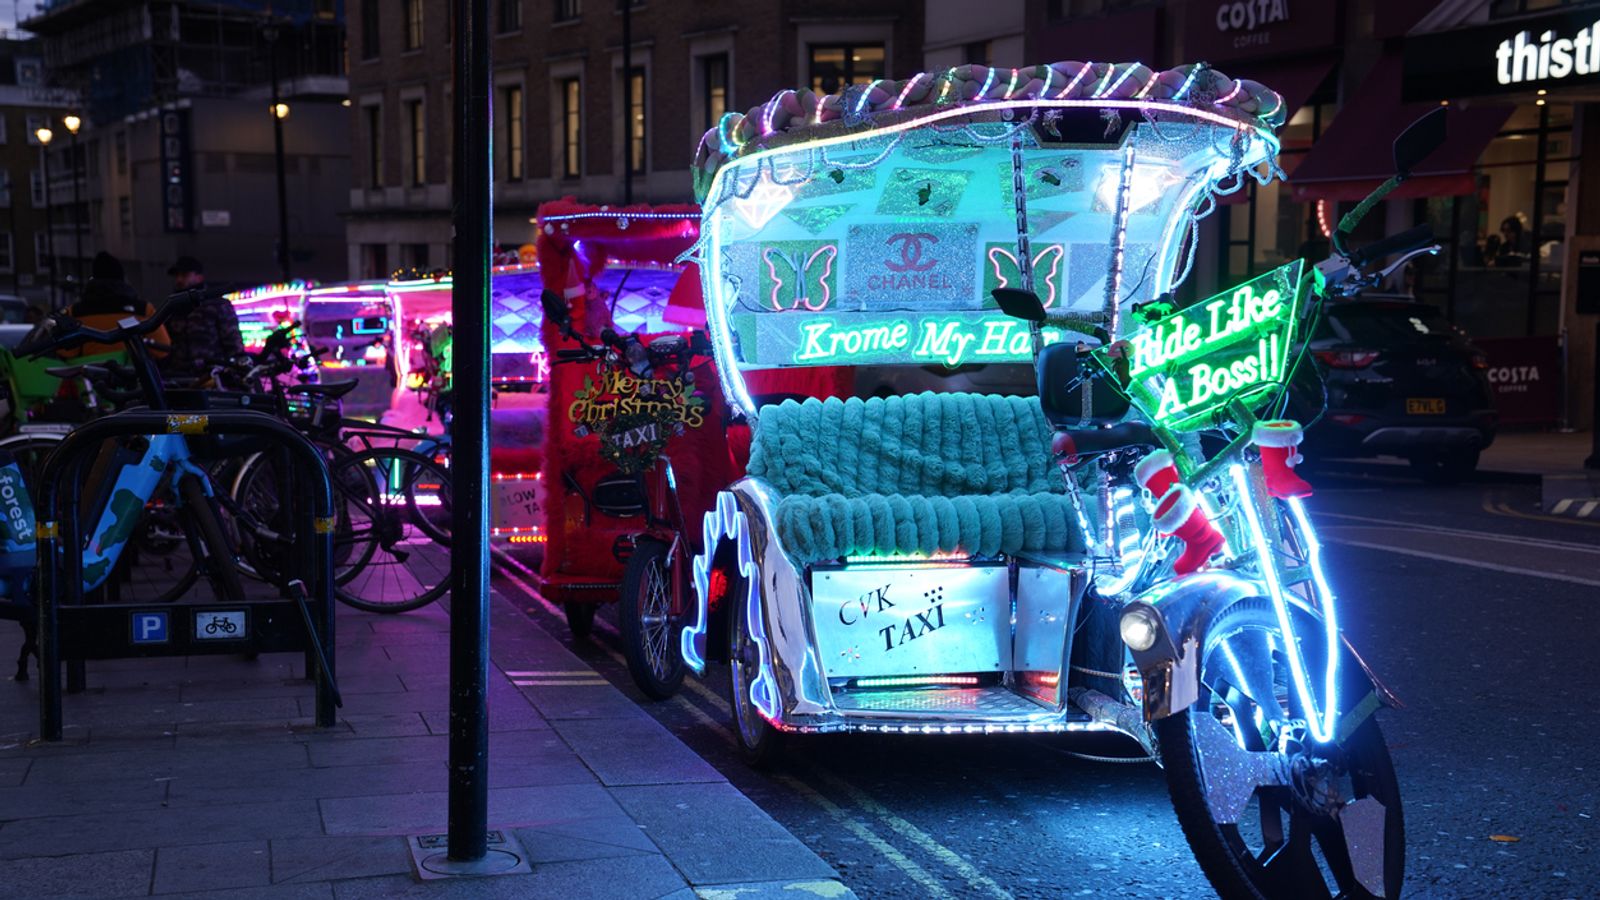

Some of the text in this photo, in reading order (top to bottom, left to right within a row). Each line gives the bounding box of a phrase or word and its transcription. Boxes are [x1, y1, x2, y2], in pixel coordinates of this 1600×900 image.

[1216, 0, 1289, 31] COSTA
[1233, 32, 1270, 49] COFFEE
[163, 112, 185, 229] ODEON
[867, 275, 952, 290] CHANEL
[800, 320, 1060, 365] Krome My Har
[1129, 284, 1282, 376] Ride Like
[598, 371, 684, 401] Merry
[1487, 366, 1540, 383] COSTA
[1498, 384, 1528, 393] COFFEE
[568, 398, 705, 428] Christmas
[1154, 377, 1187, 420] A
[612, 423, 657, 448] TAXI
[0, 475, 33, 540] forest
[839, 584, 895, 626] CVK
[142, 616, 161, 640] P
[878, 604, 946, 652] TAXI
